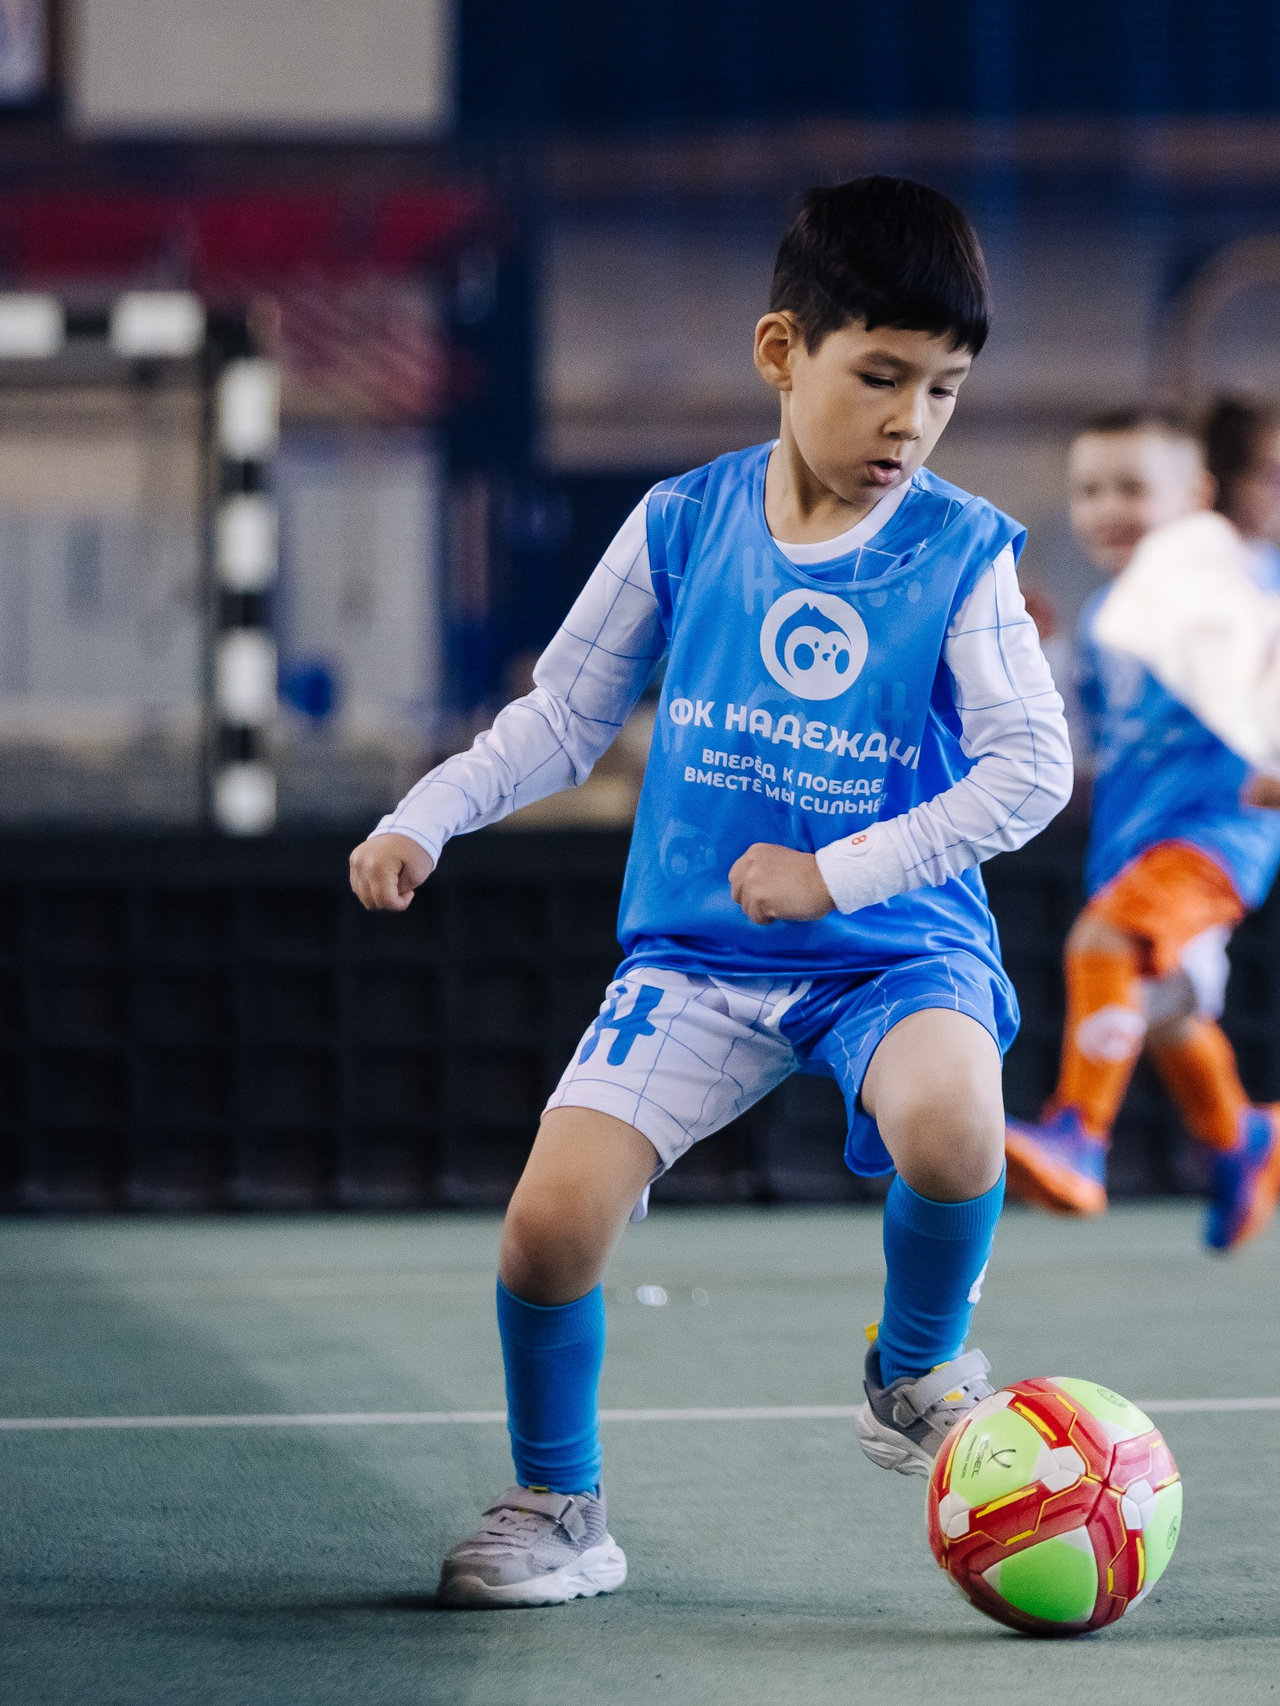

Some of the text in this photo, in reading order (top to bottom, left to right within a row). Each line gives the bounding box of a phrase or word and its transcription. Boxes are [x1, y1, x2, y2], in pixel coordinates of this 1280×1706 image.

[669, 698, 716, 728] ФК
[702, 748, 776, 782] ВПЕРЁД
[782, 766, 794, 784] К
[684, 766, 763, 793] ВМЕСТЕ
[765, 783, 796, 806] МЫ
